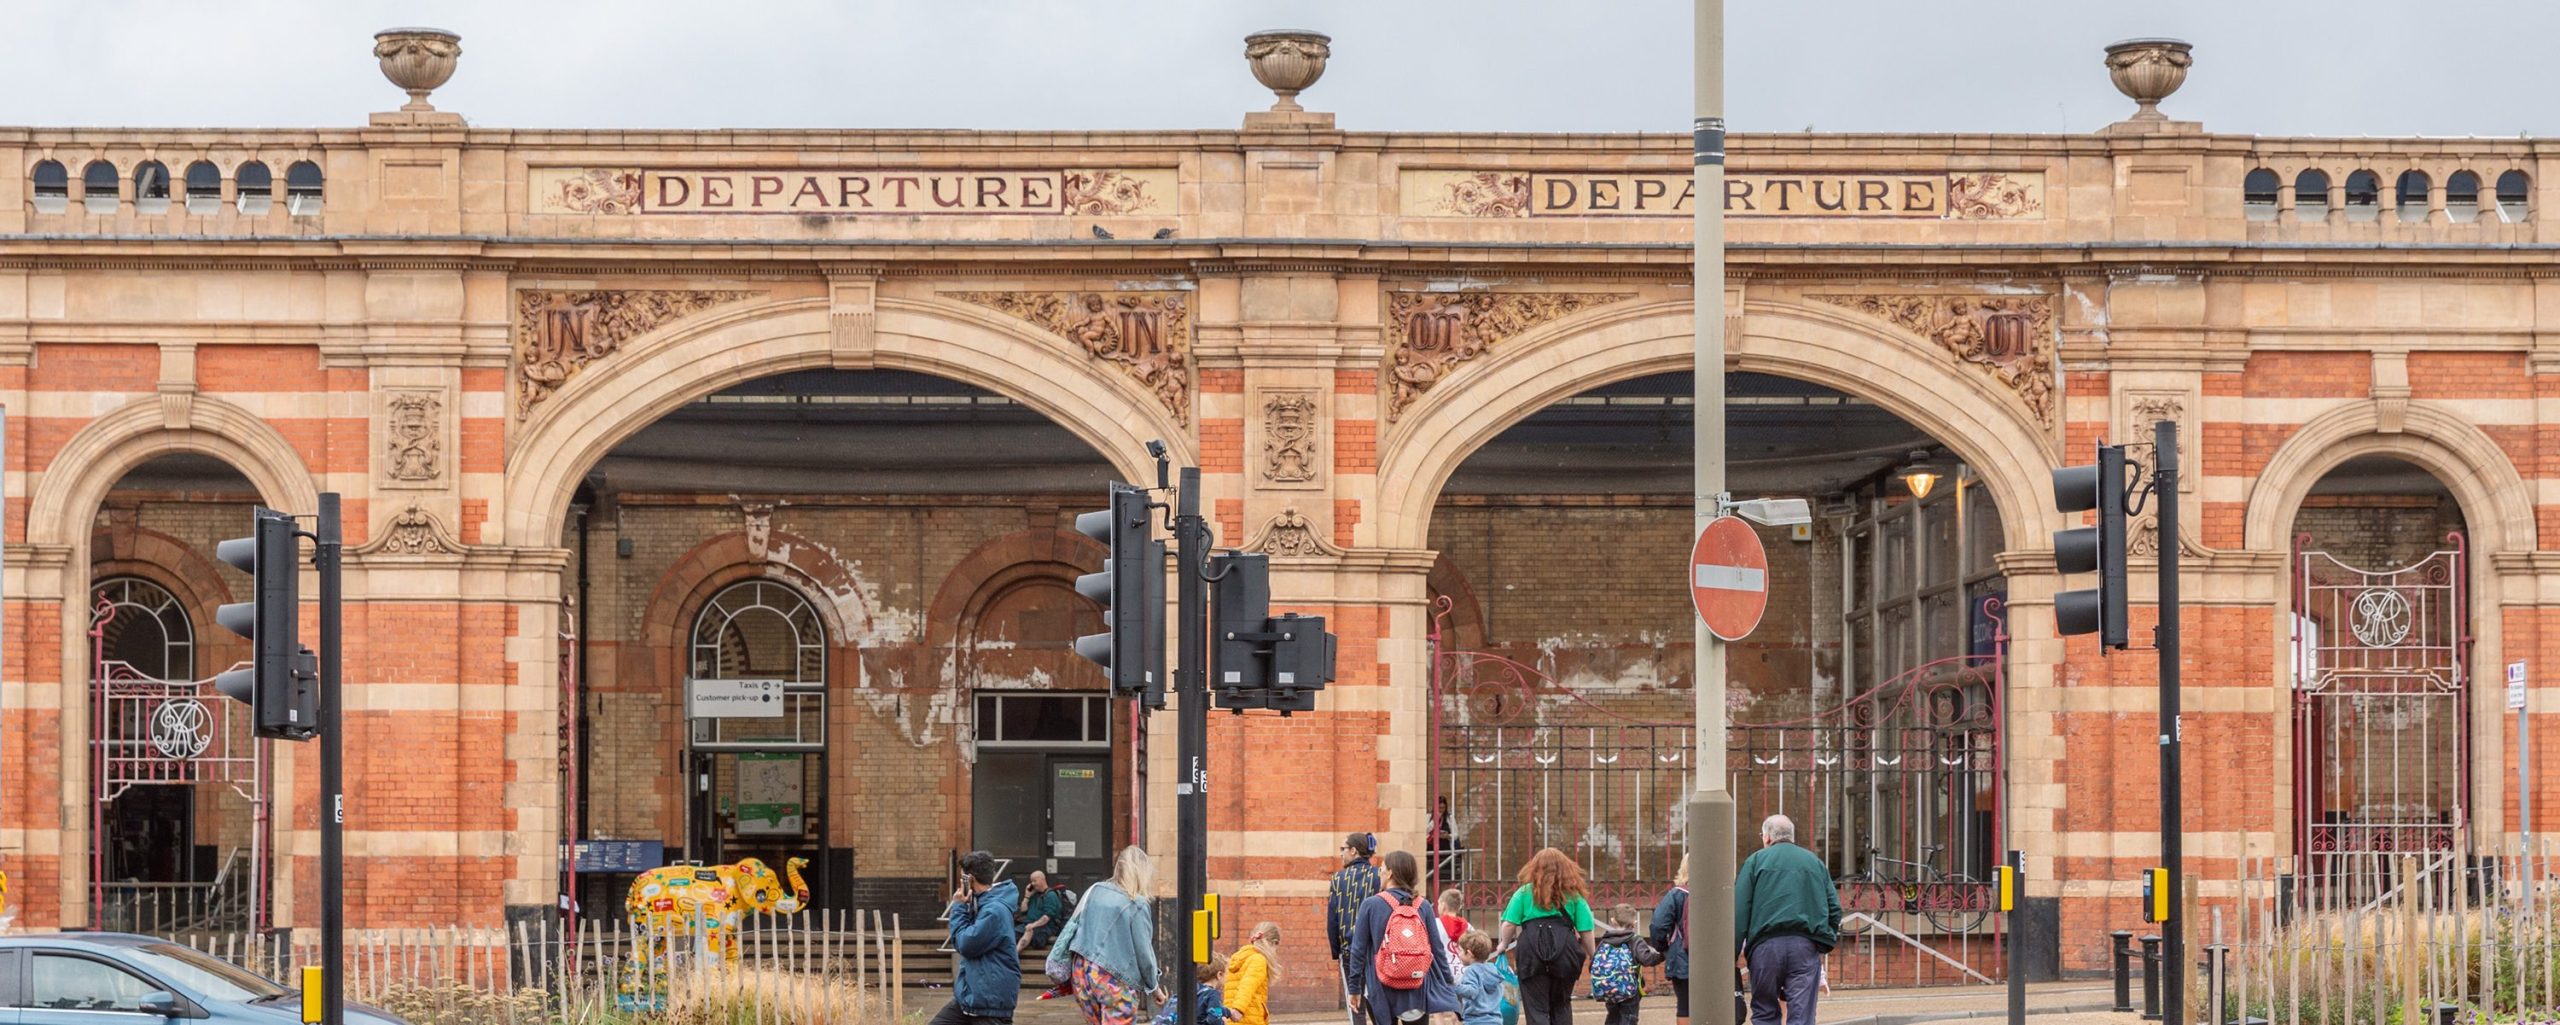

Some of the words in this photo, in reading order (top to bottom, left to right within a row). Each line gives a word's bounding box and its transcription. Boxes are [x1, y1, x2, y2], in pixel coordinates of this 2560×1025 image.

[657, 176, 1053, 208] DEPARTURE
[545, 309, 589, 359] IN
[1120, 311, 1162, 359] IN
[695, 694, 730, 702] Customer
[731, 694, 759, 702] pick-up
[739, 681, 759, 689] Taxis
